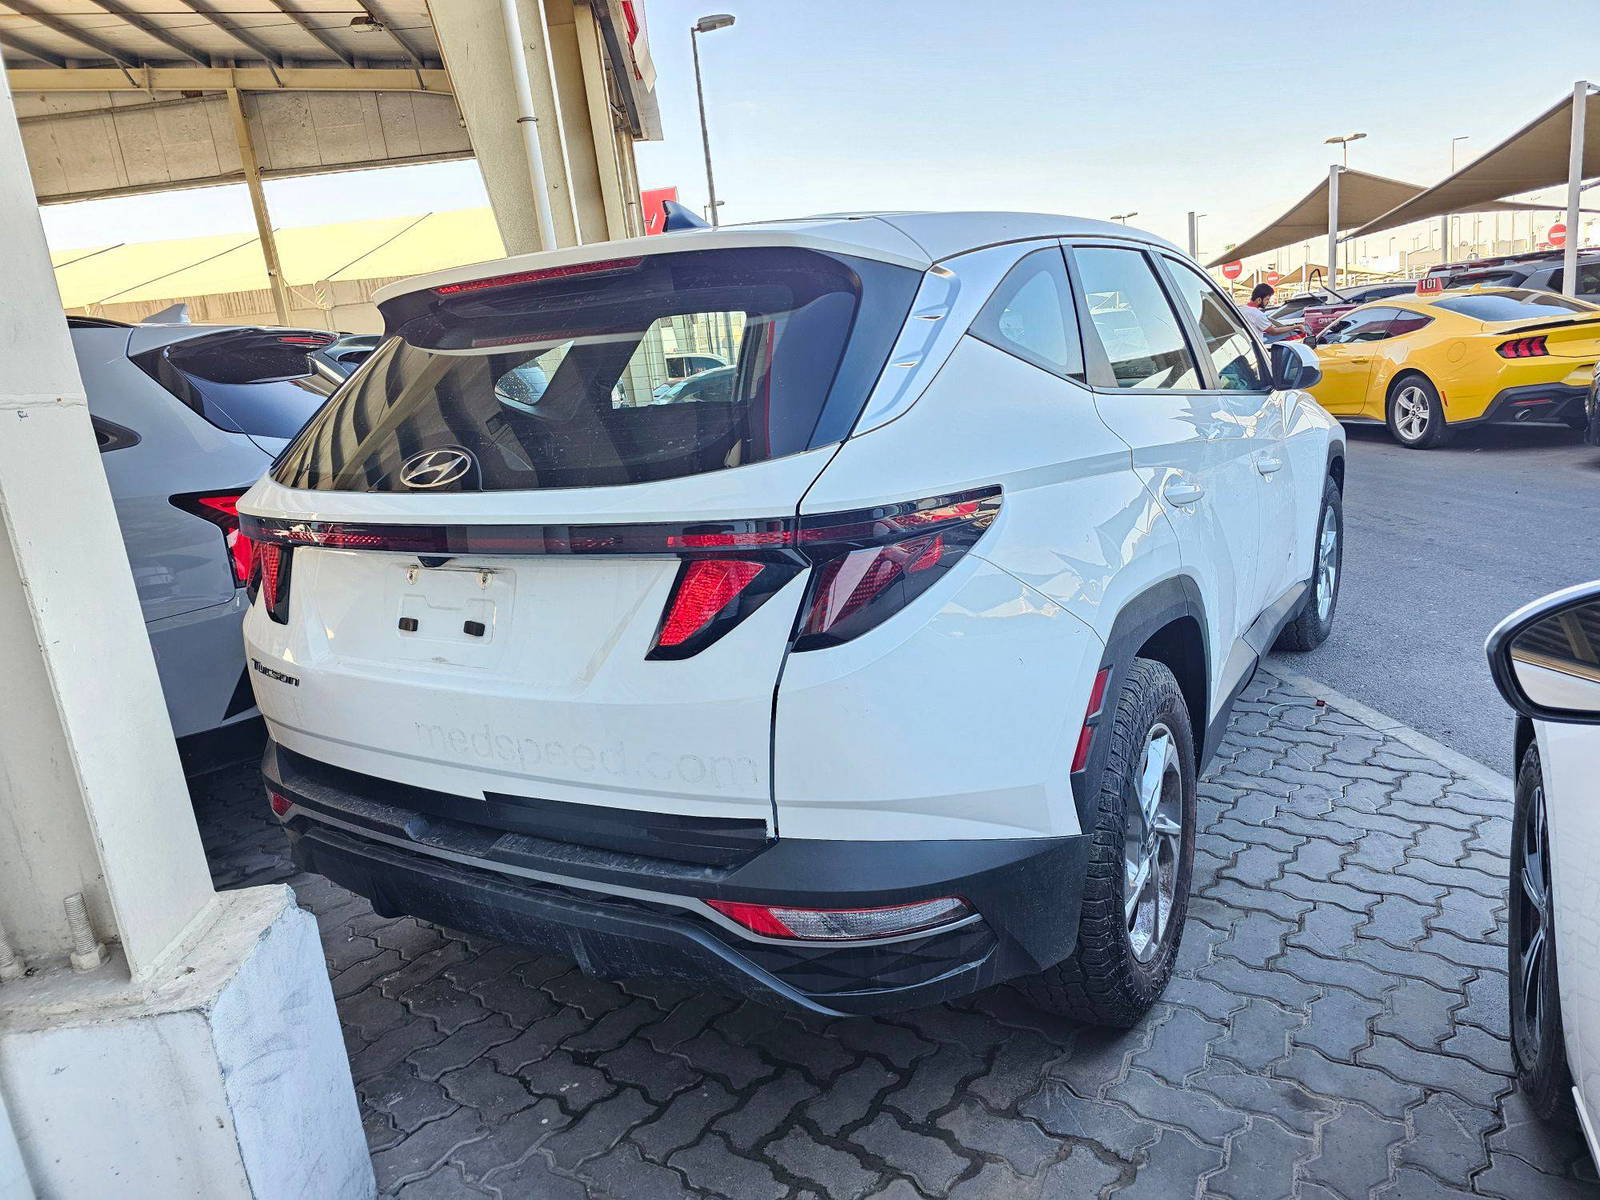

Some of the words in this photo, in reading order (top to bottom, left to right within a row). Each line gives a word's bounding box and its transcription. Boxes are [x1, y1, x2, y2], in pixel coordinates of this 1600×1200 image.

[1422, 279, 1436, 289] 101
[251, 658, 300, 687] Tucson
[414, 721, 759, 788] medspeed.com
